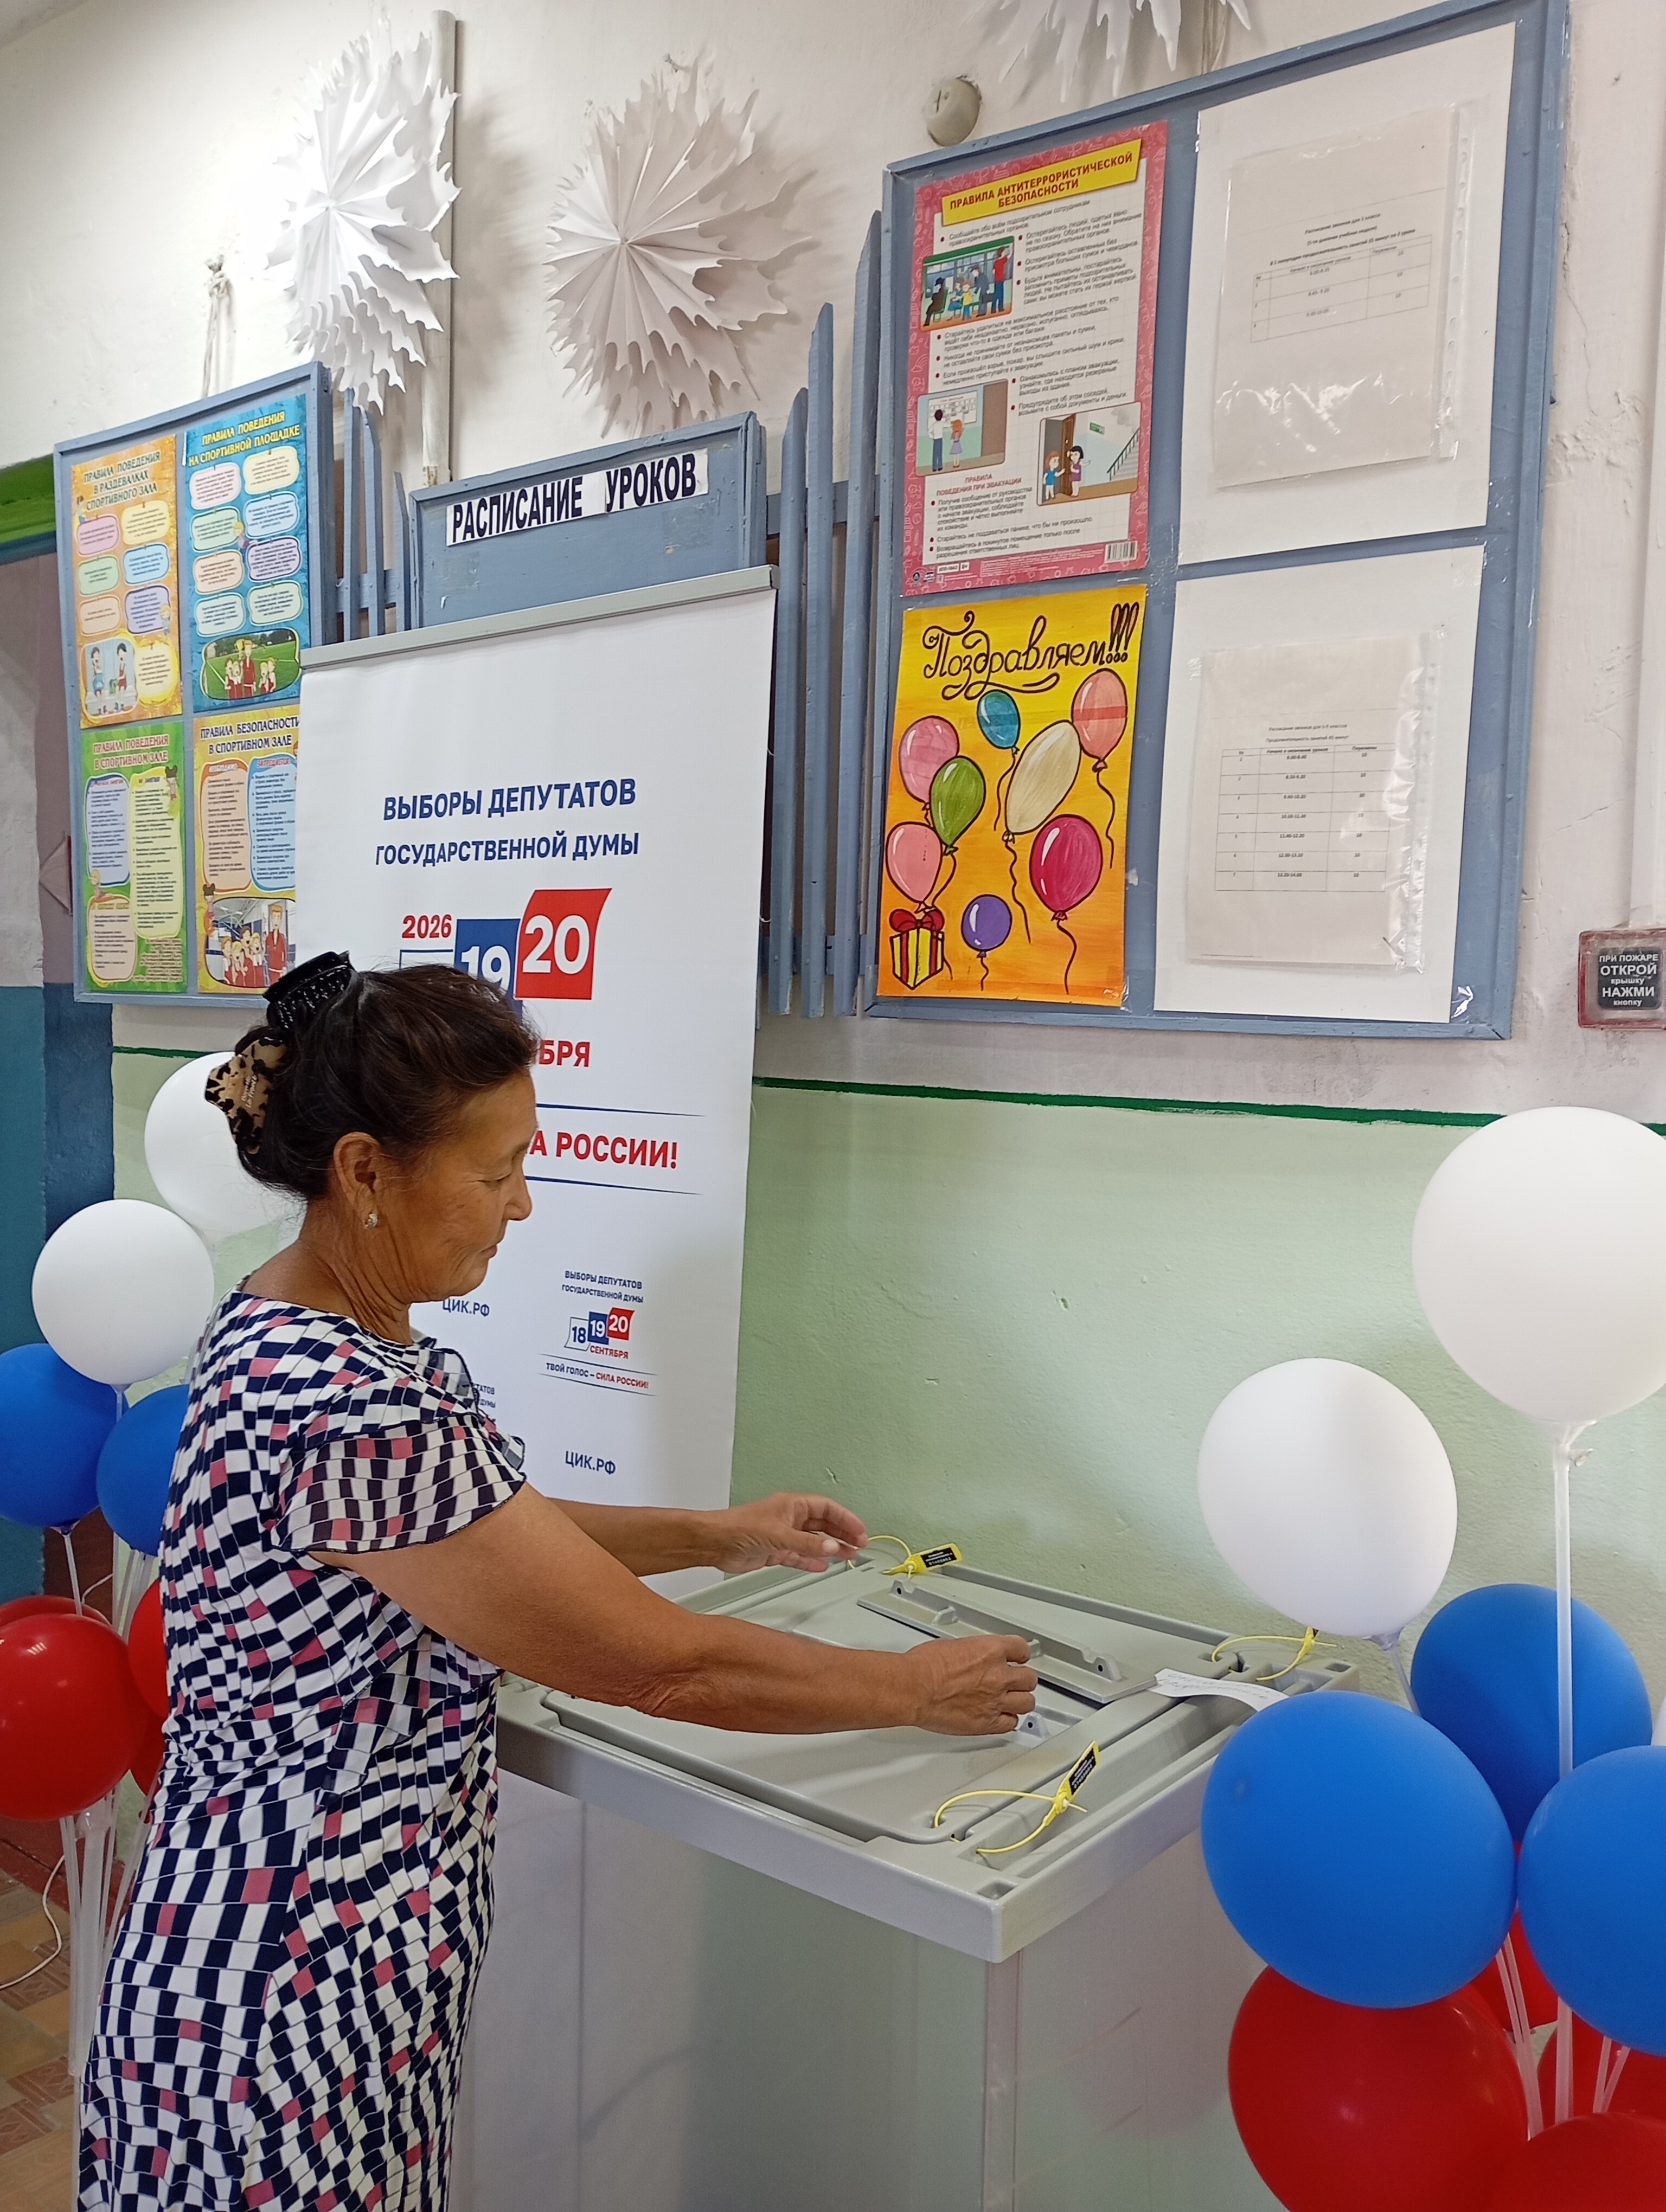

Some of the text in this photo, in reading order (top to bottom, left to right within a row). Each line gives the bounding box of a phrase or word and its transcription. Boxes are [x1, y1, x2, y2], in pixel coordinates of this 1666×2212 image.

[950, 151, 1132, 210] ПРАВИЛА АНТИТЕРРОРИСТИЧЕСКОЙ
[998, 178, 1078, 208] БЕЗОПАСНОСТИ
[202, 411, 285, 445] ПРАВИЛА ПОВЕДЕНИЯ
[188, 426, 300, 467] НА СПОРТИВНОЙ ПЛОЩАДКЕ
[85, 452, 160, 480] ПРАВИЛА ПОВЕДЕНИЯ
[965, 473, 992, 483] ПРАВИЛА
[93, 471, 149, 494] В РАЗДЕВАЛКАХ
[935, 477, 1022, 497] ПОВЕДЕНИЯ ПРИ ЭВАКУАЦИИ
[86, 483, 157, 510] СПОРТИВНОГО ЗАЛА
[452, 453, 696, 543] РАСПИСАНИЕ УРОКОВ
[922, 602, 1139, 700] Поздравляем!!!
[94, 736, 169, 753] ПРАВИЛА ПОВЕДЕНИЯ
[201, 726, 233, 739] ПРАВИЛА
[209, 736, 291, 754] В СПОРТИВНОМ ЗАЛЕ
[94, 752, 168, 769] В СПОРТИВНОМ ЗАЛЕ
[384, 779, 636, 821] ВЫБОРЫ ДЕПУТАТОВ
[375, 831, 639, 866] ГОСУДАРСТВЕННОЙ ДУМЫ
[402, 914, 452, 938] 2026
[523, 914, 590, 975] 20
[1600, 962, 1657, 975] ОТКРОЙ
[1602, 987, 1655, 997] НАЖМИ
[556, 1131, 677, 1169] РОССИИ!
[565, 1270, 643, 1290] ВЫБОРЫ ДЕПУТАТОВ
[562, 1284, 644, 1303] ГОСУДАРСТВЕННОЙ ДУМЫ
[443, 1298, 490, 1317] ЦИК.РФ
[572, 1315, 629, 1343] 18 19 20
[590, 1345, 629, 1360] СЕНТЯБРЯ
[546, 1361, 565, 1373] ТВОЙ
[566, 1366, 588, 1378] ГОЛОС
[596, 1372, 615, 1383] СИЛА
[616, 1375, 649, 1388] РОССИИ!
[565, 1451, 616, 1475] ЦИК.РФ
